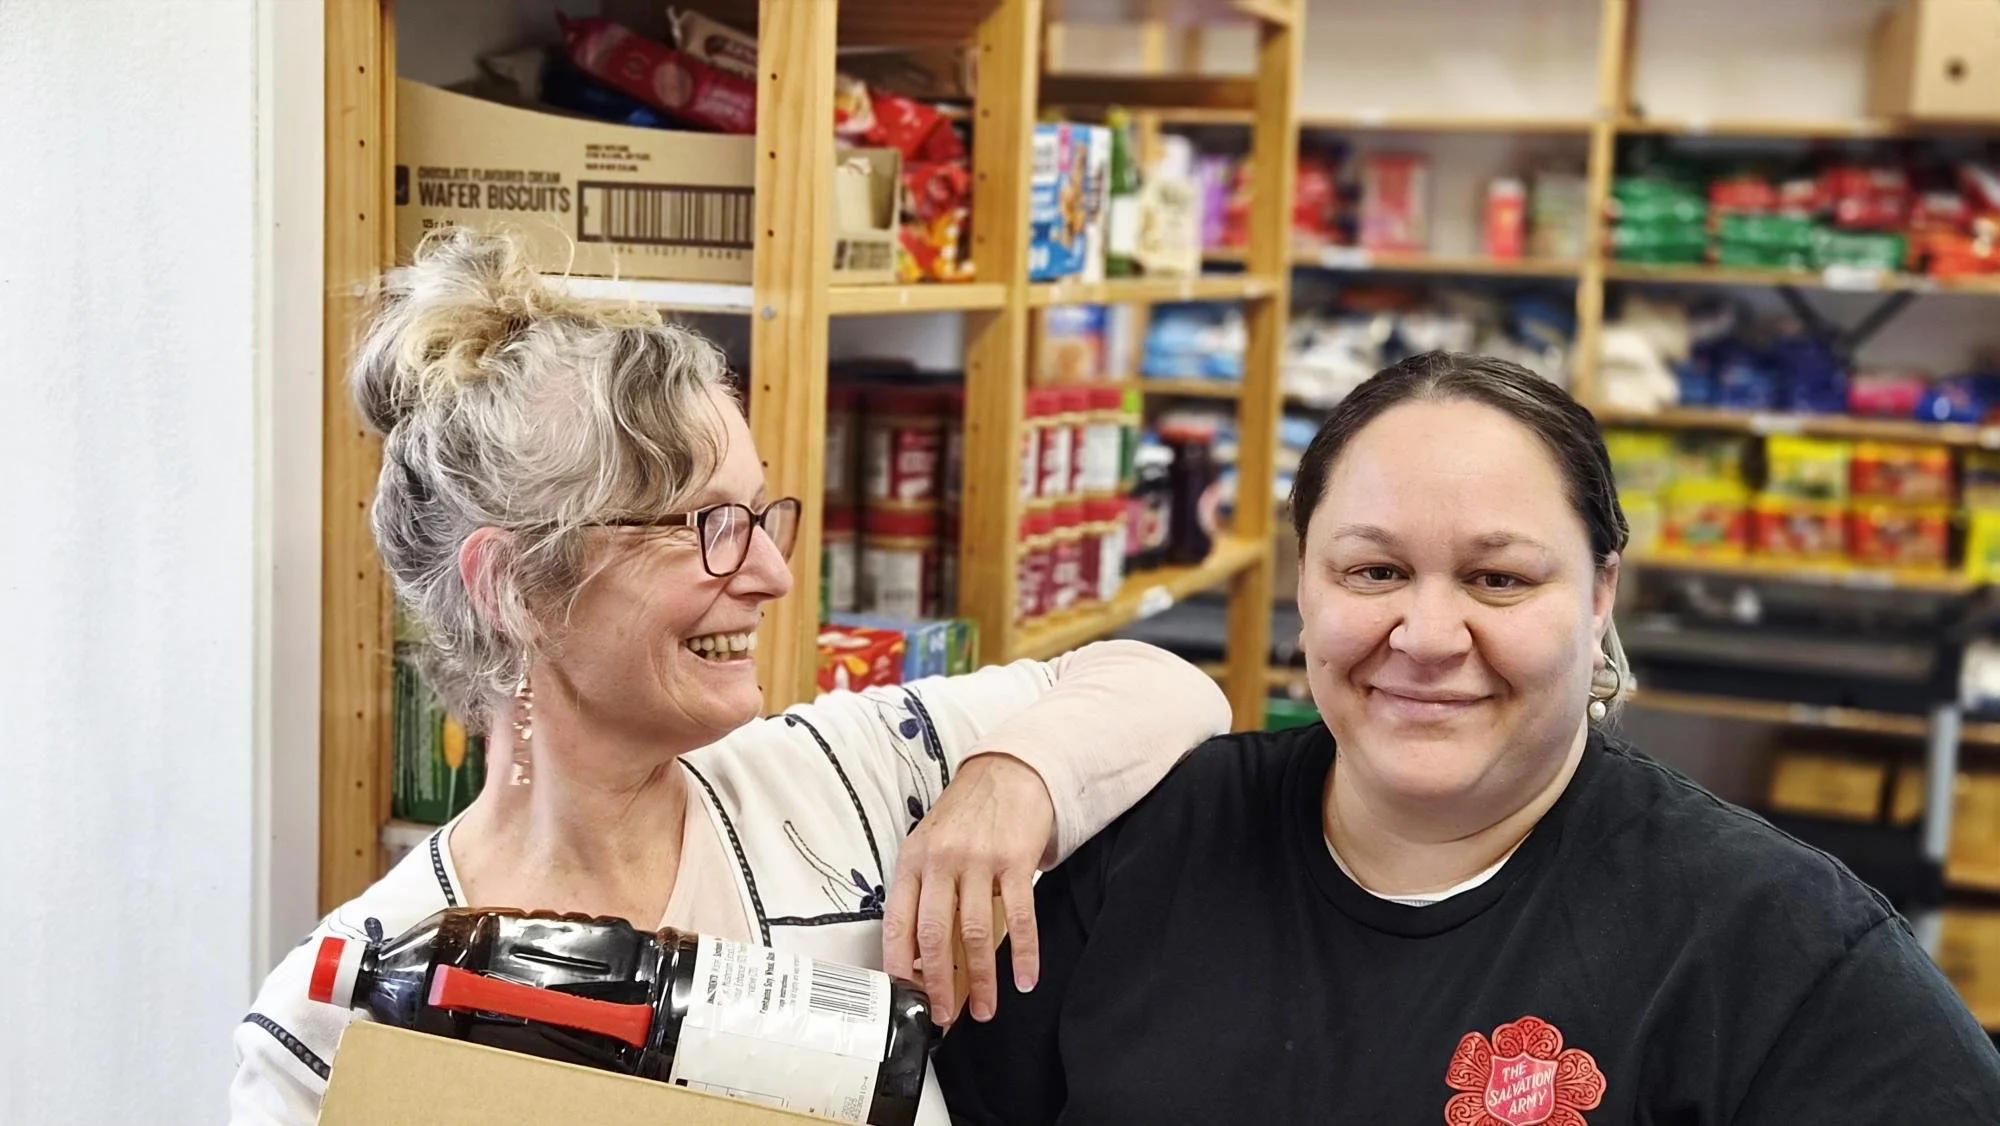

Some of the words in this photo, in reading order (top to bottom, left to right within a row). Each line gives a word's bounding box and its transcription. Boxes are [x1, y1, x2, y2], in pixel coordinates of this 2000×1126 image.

[418, 166, 469, 181] CHOCOLATE
[472, 168, 524, 182] FLAVOURED
[527, 170, 561, 184] CREAM
[418, 182, 480, 208] WAFER
[487, 184, 571, 212] BISCUITS
[1501, 1060, 1528, 1083] THE
[1488, 1069, 1551, 1107] SALVATION
[1508, 1087, 1548, 1118] ARMY
